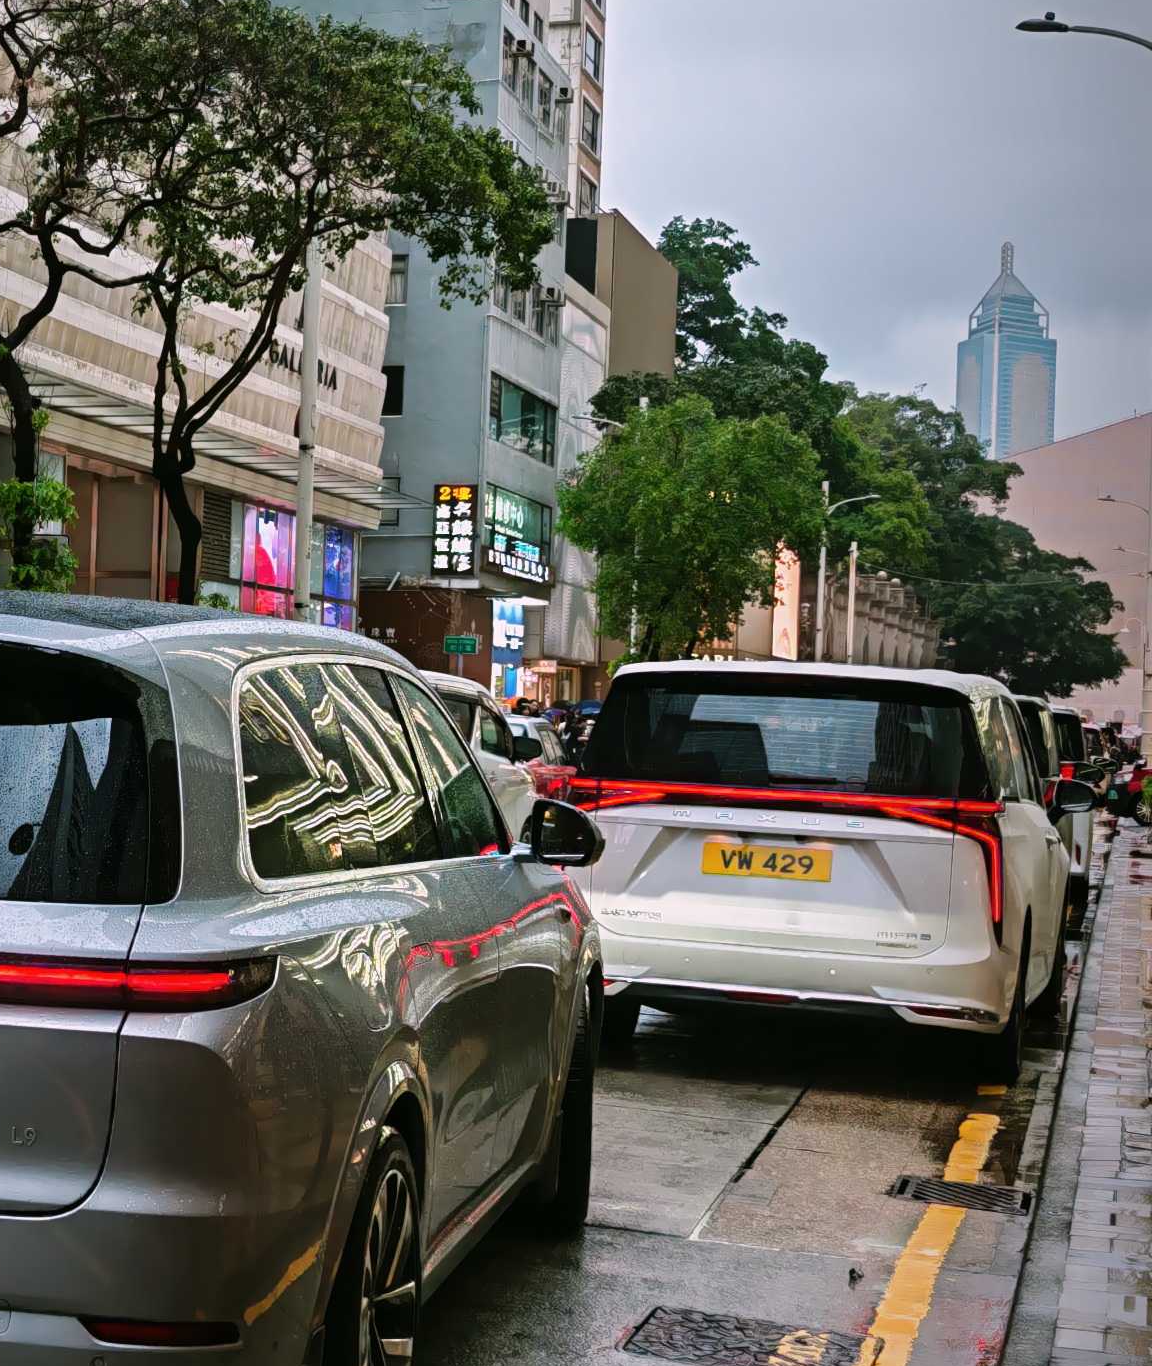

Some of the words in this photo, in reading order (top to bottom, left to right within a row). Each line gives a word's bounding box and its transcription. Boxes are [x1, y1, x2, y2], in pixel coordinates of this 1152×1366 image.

[673, 808, 865, 829] MAXUS
[720, 849, 754, 871] VW
[761, 853, 814, 875] 429
[11, 1126, 37, 1146] L9
